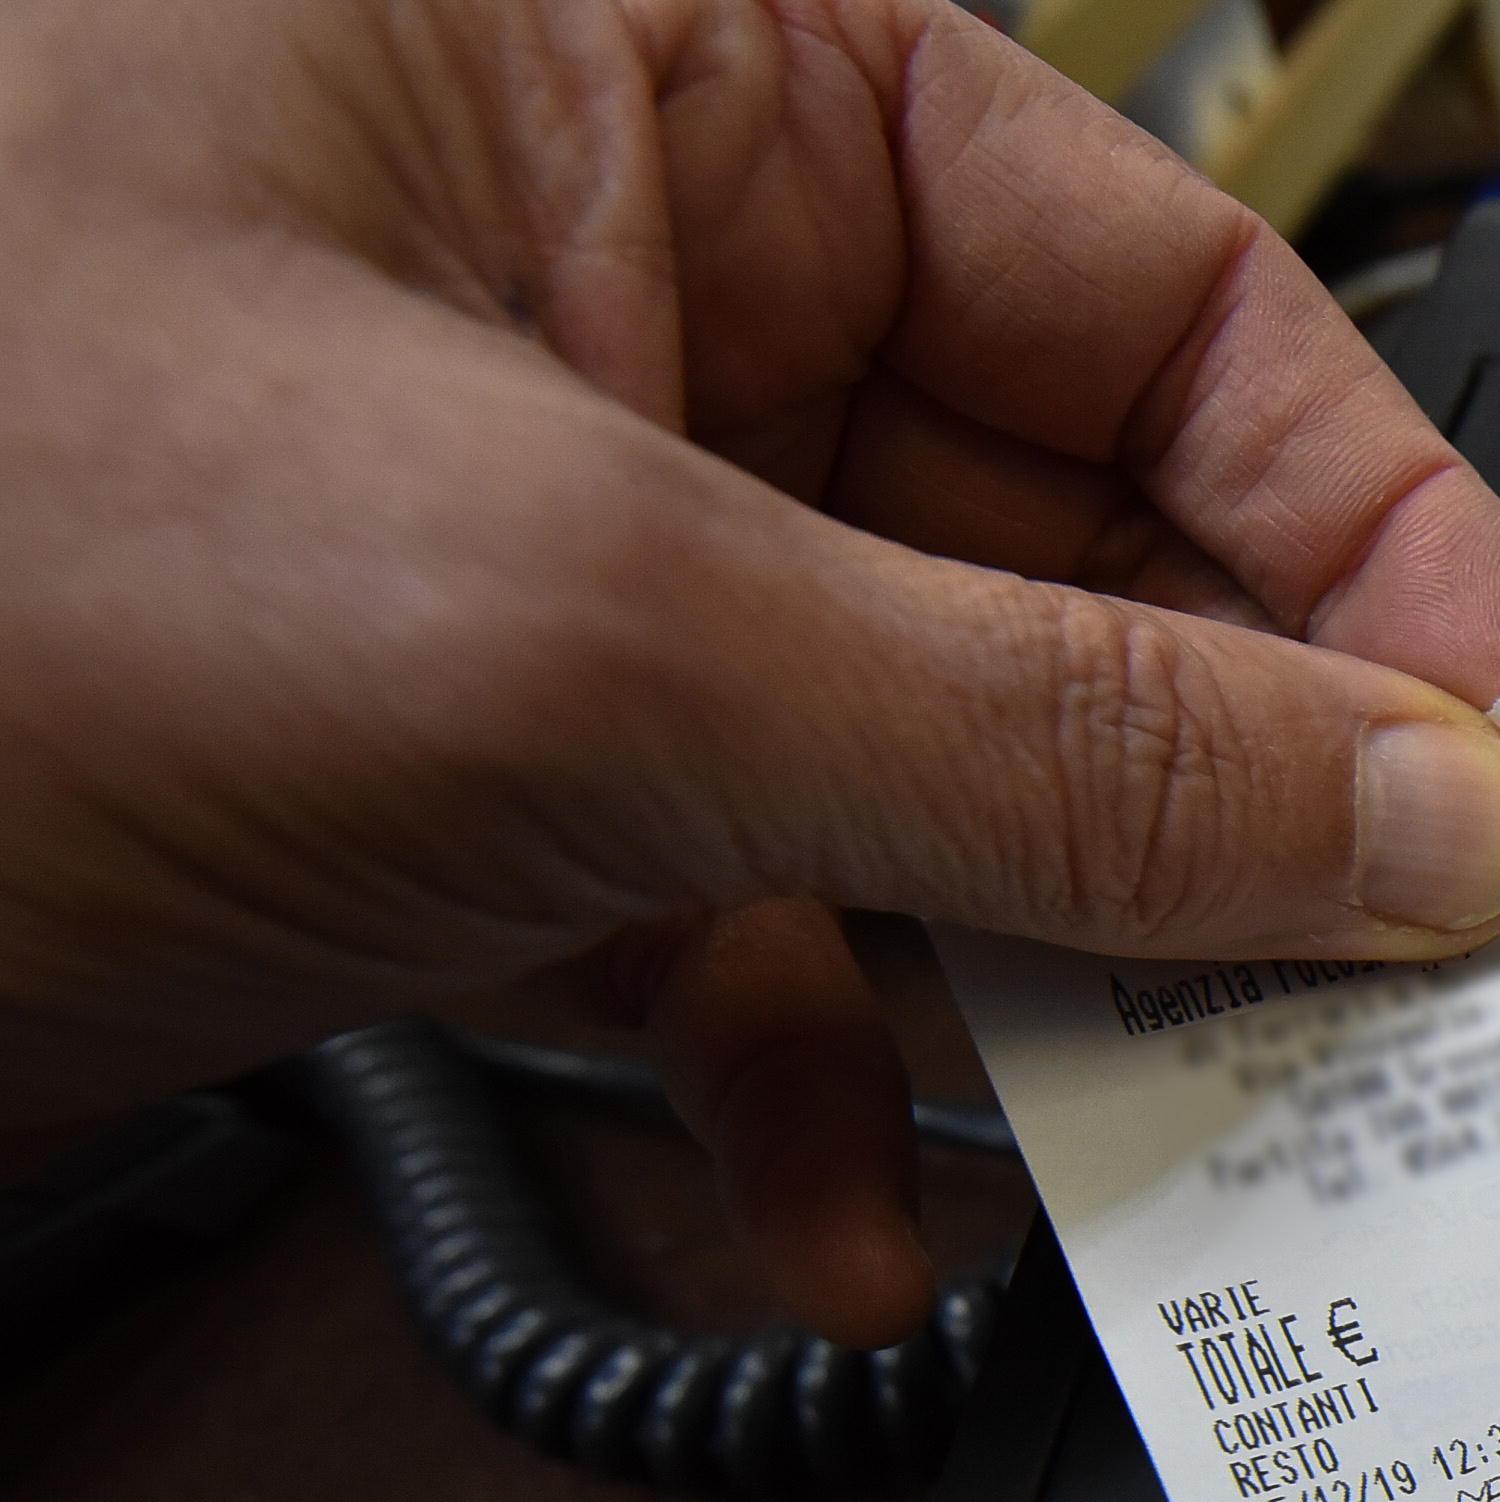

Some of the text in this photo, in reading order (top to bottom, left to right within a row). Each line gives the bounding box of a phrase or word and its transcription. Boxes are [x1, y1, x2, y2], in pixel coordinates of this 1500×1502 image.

[1110, 962, 1264, 1036] Agenzia
[1156, 1280, 1272, 1336] VARIE
[1175, 1313, 1323, 1411] TOTALE
[1326, 1297, 1379, 1367] €
[1213, 1377, 1380, 1455] CONTANTI
[1229, 1437, 1341, 1499] RESTO
